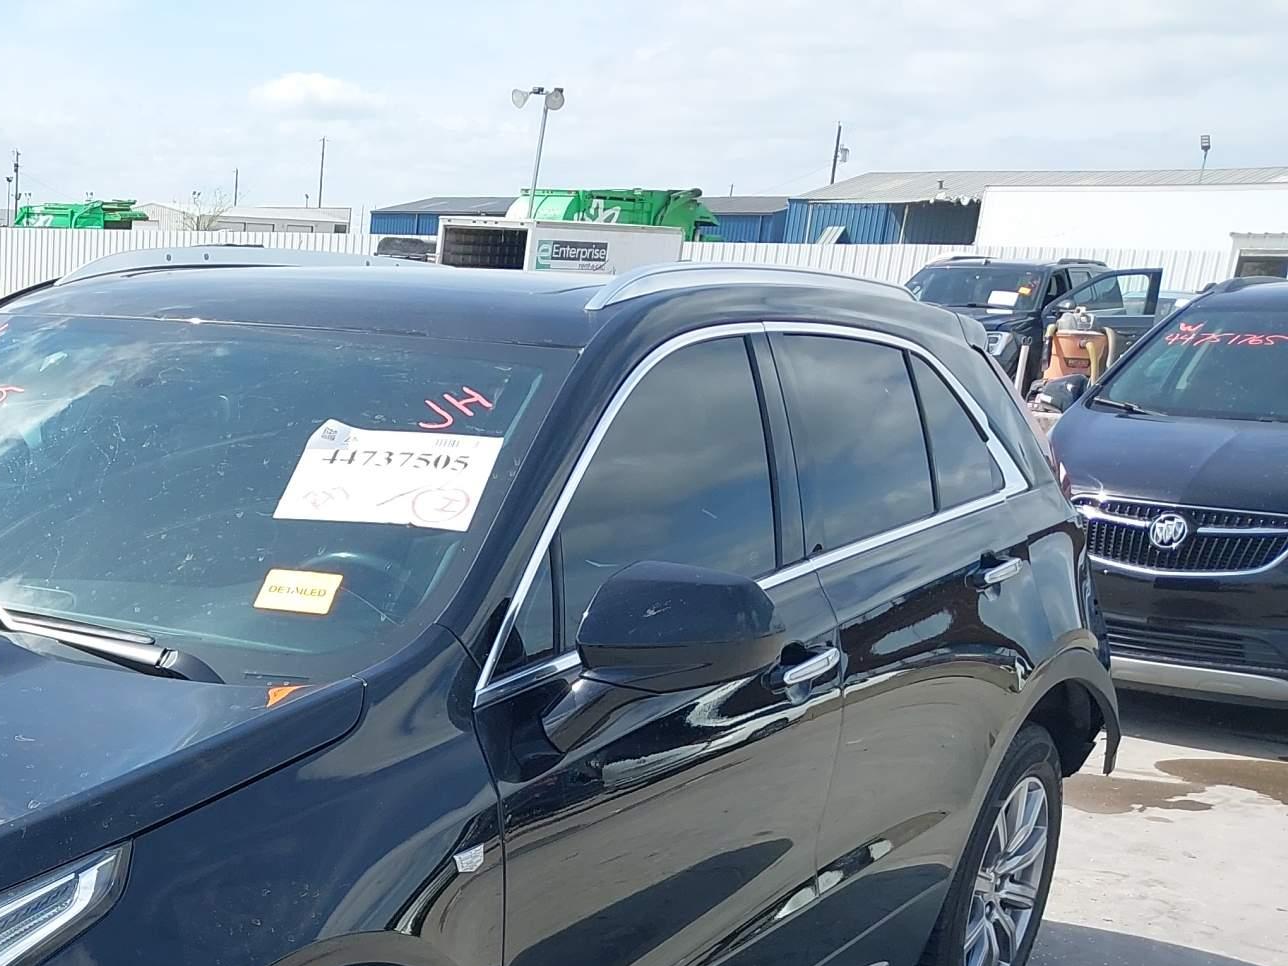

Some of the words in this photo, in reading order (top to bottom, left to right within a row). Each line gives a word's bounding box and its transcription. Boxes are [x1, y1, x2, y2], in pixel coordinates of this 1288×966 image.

[552, 244, 607, 262] Enterprise
[418, 386, 494, 429] JH
[321, 449, 470, 471] 44737505
[268, 585, 327, 598] DETAILED
